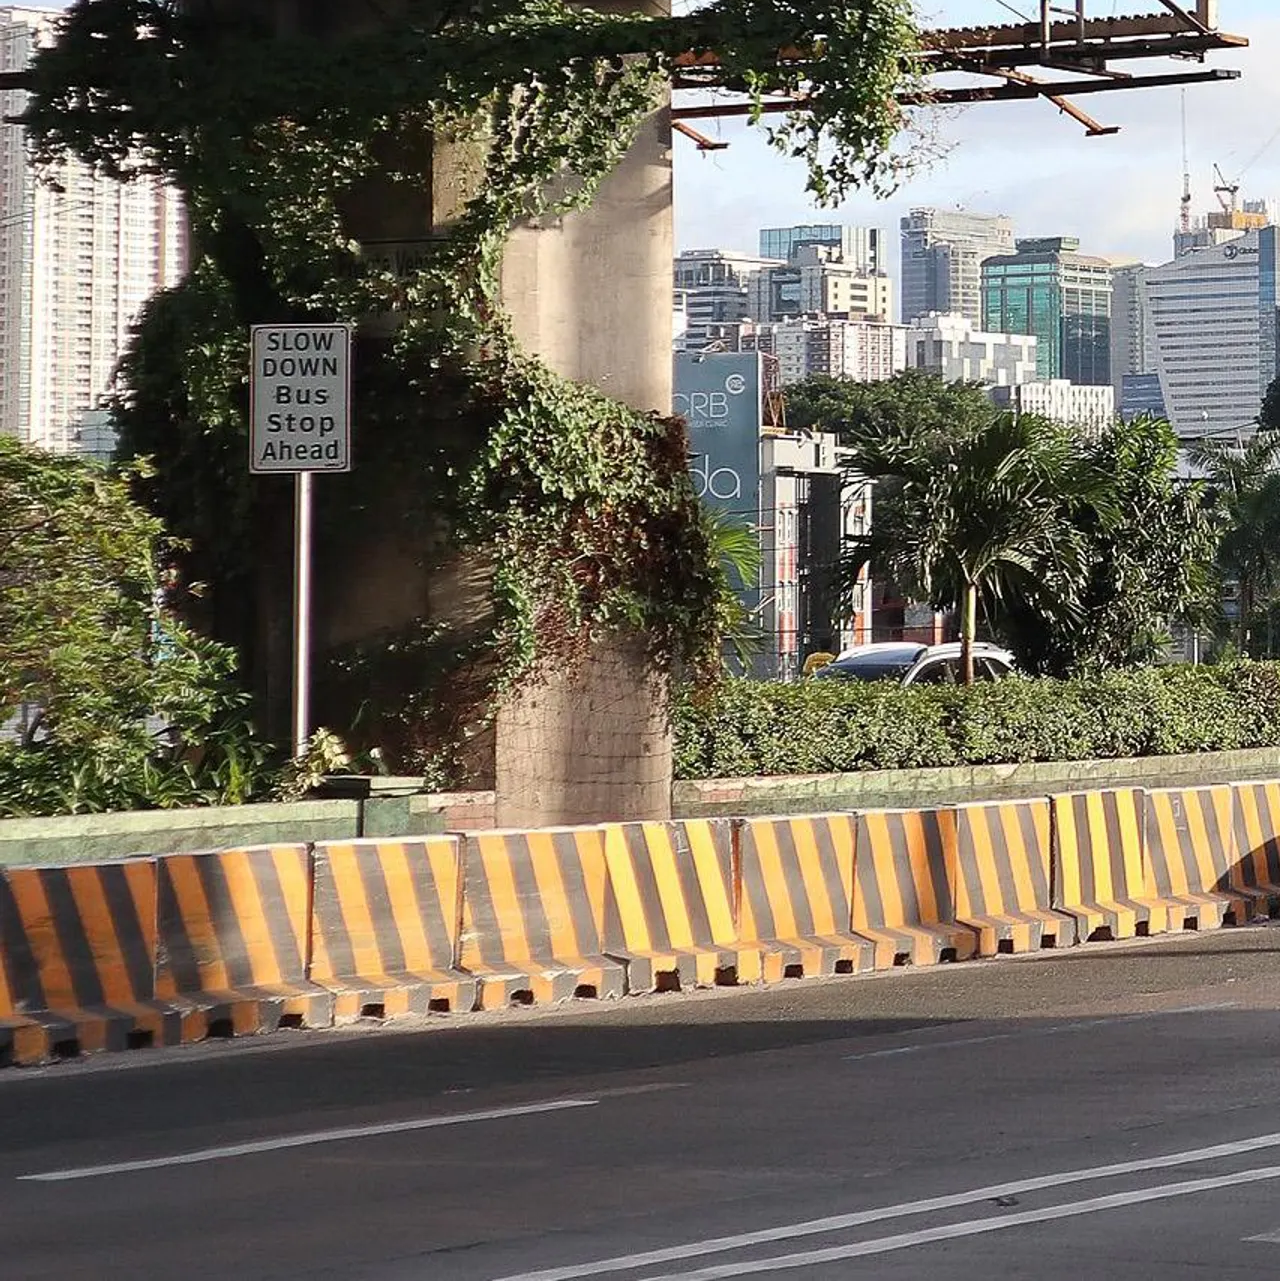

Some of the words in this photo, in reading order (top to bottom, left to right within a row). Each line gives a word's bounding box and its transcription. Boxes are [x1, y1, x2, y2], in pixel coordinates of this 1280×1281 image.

[267, 332, 334, 351] SLOW
[262, 358, 337, 377] DOWN
[275, 385, 330, 404] Bus
[267, 413, 335, 437] Stop
[261, 440, 339, 461] Ahead
